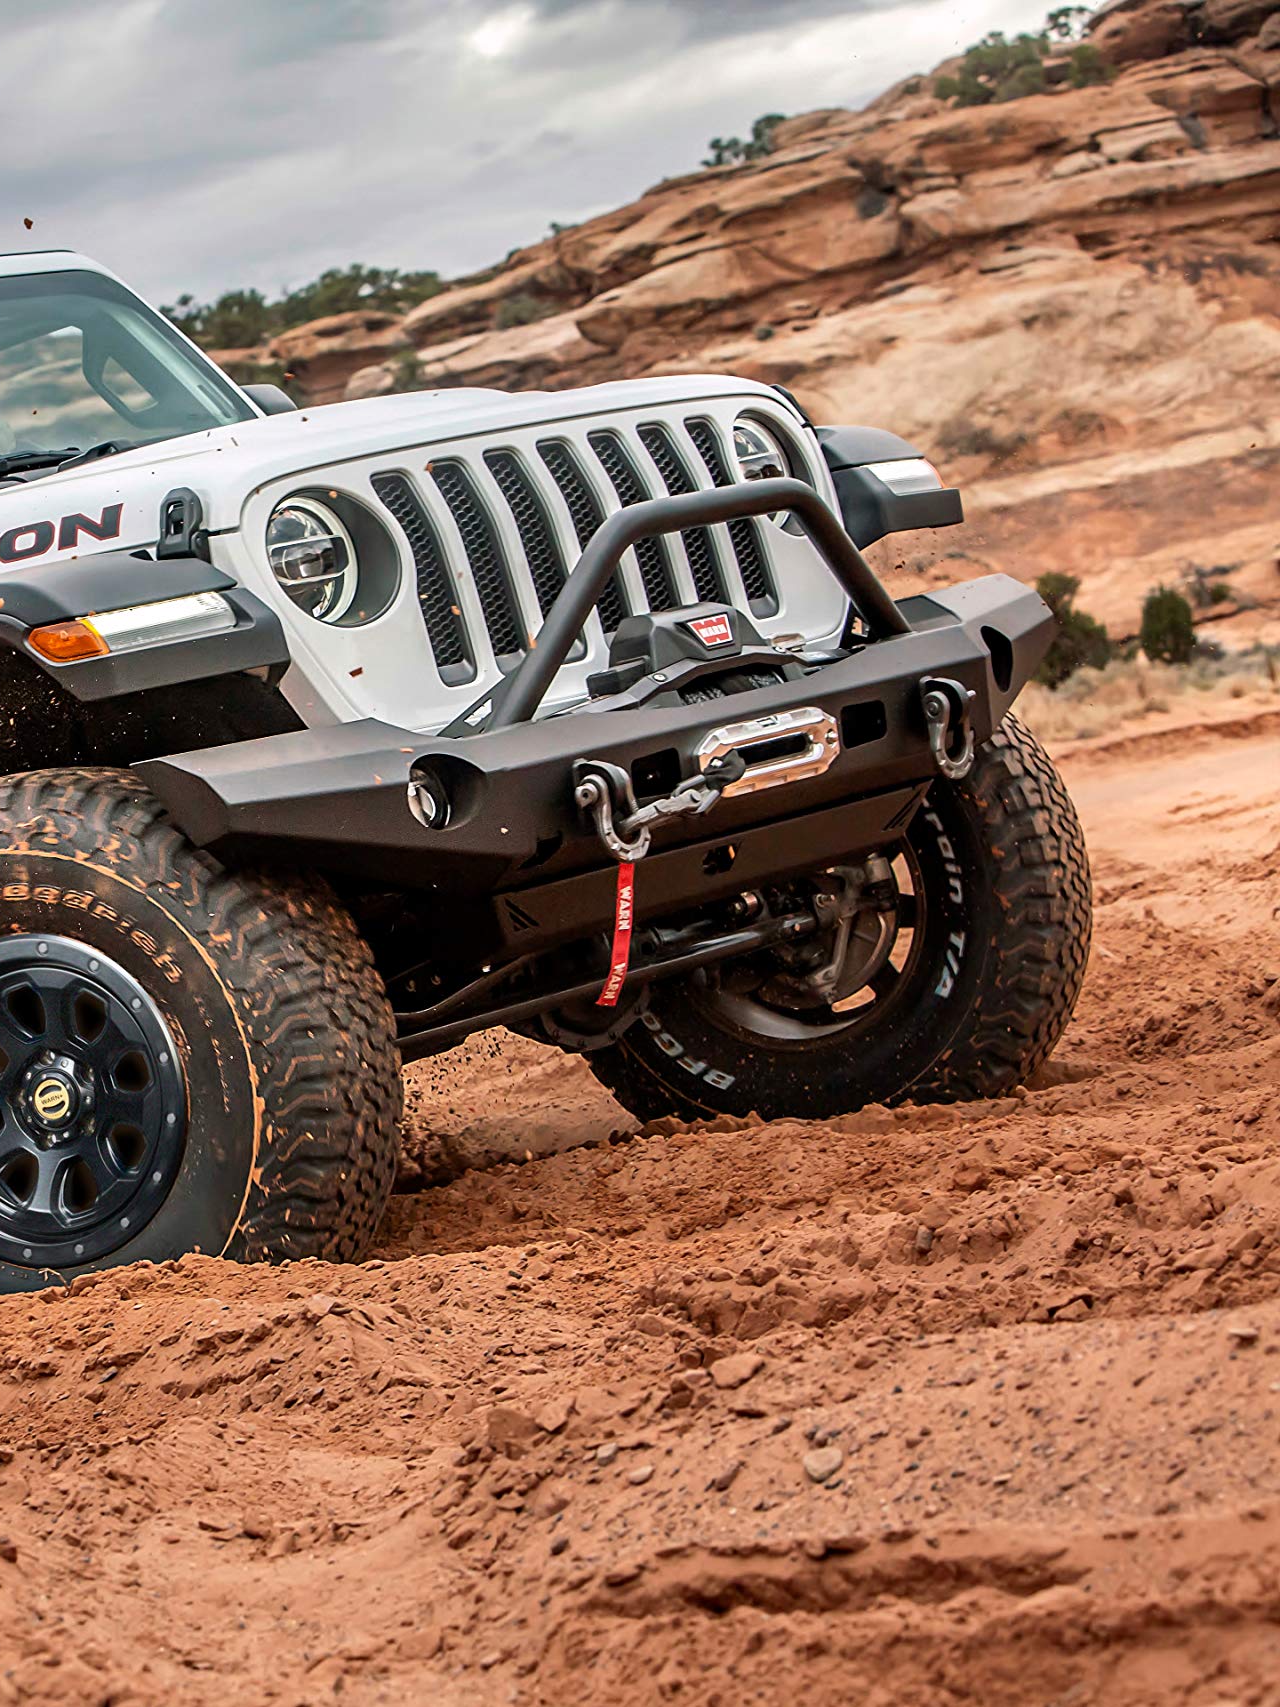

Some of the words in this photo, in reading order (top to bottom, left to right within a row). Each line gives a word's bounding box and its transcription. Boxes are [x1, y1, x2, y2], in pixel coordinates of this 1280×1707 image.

[698, 623, 728, 638] WARN
[923, 798, 961, 904] rain
[618, 885, 632, 931] WARN
[603, 962, 626, 1000] WARN
[934, 930, 965, 998] T/A
[641, 1011, 736, 1091] BFGo
